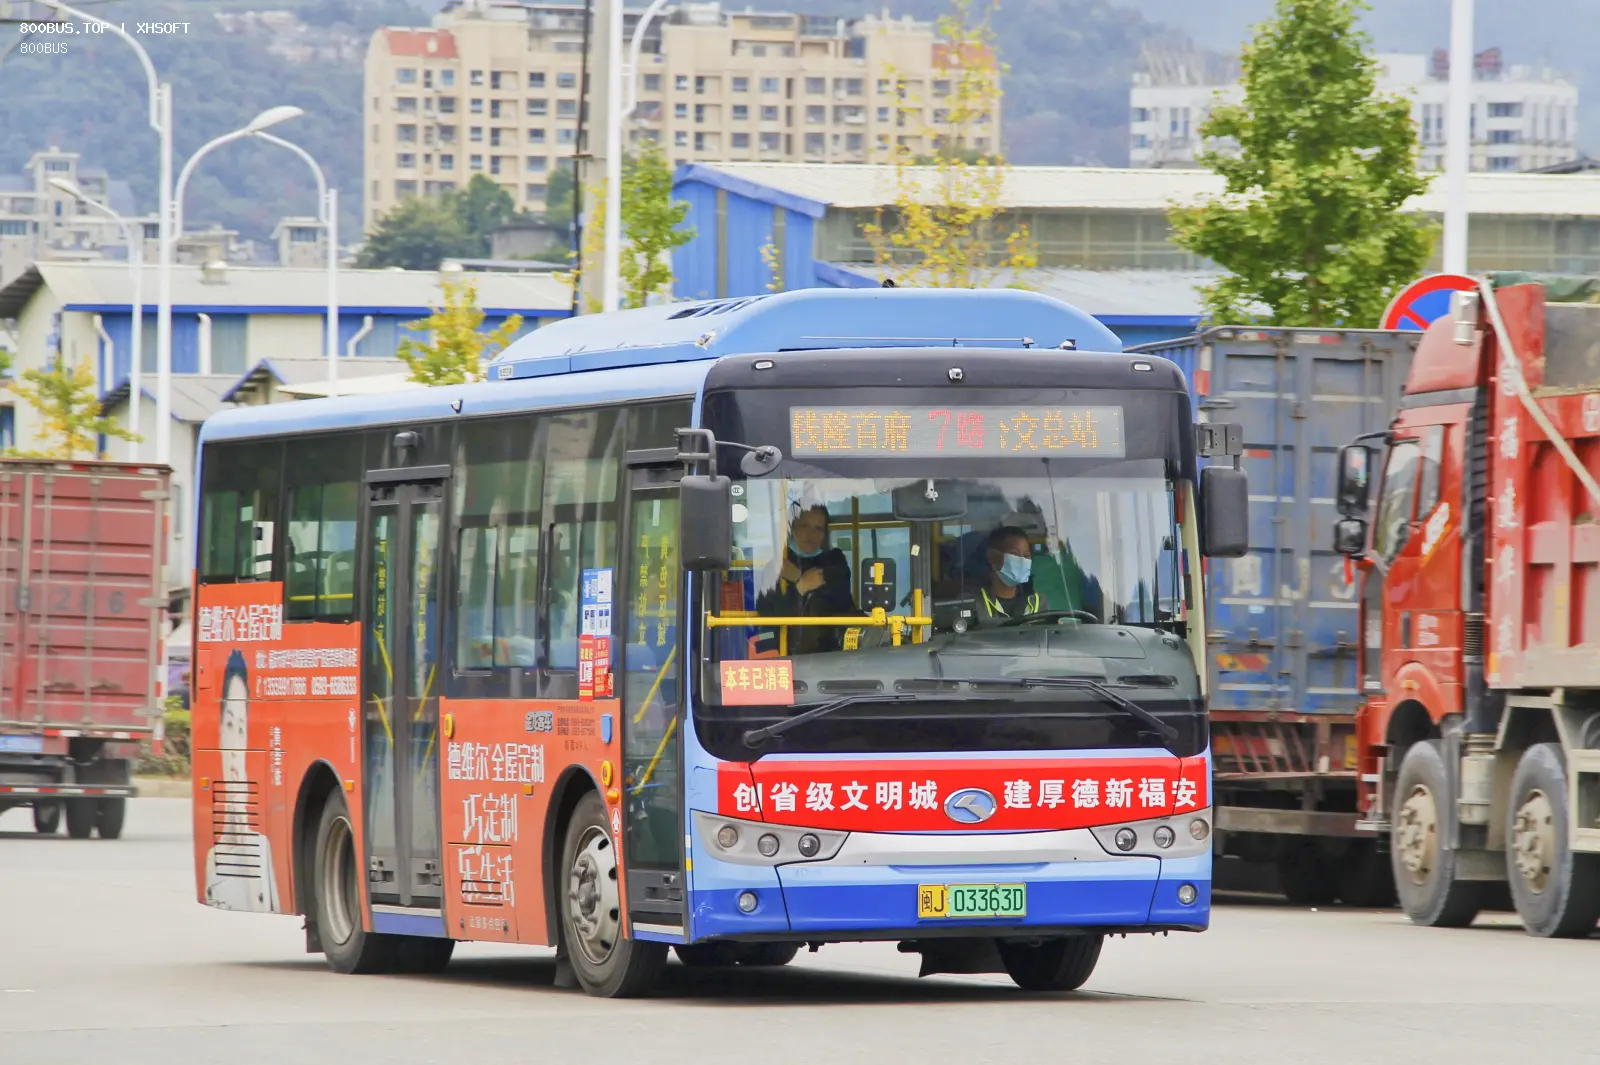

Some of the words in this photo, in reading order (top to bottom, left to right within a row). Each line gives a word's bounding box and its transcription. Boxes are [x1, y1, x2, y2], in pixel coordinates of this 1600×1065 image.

[724, 666, 790, 691] 本车已消毒
[733, 779, 939, 813] 创省级文明城
[1003, 777, 1198, 809] 建厚德新福安
[462, 792, 518, 856] 巧定制
[458, 846, 515, 908] 乐生活
[954, 888, 1023, 912] 03363D
